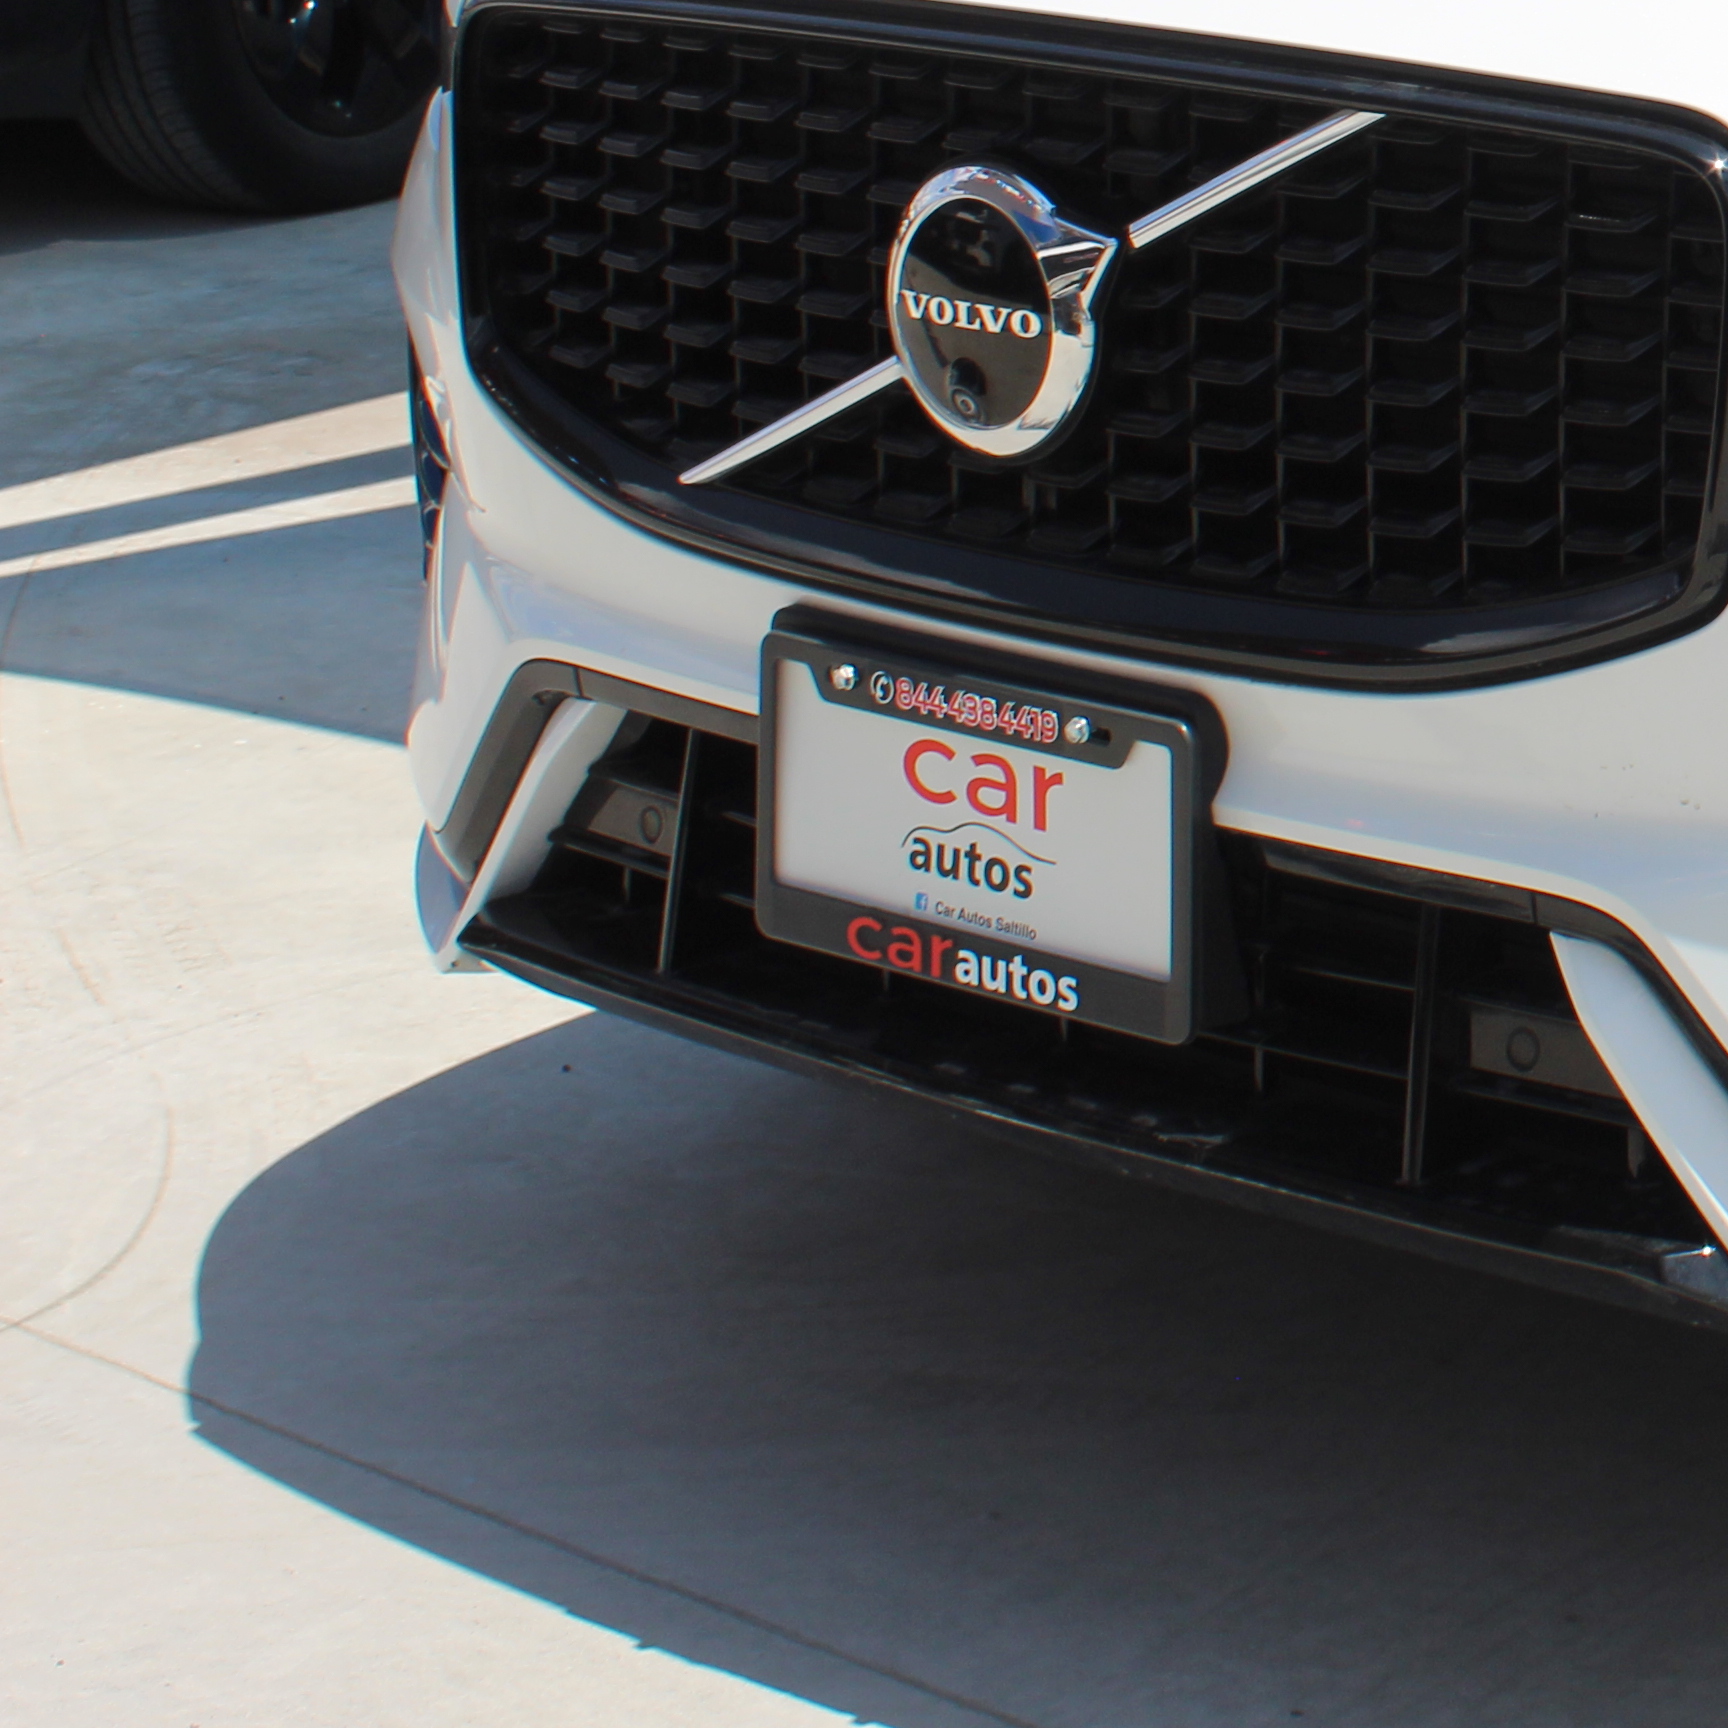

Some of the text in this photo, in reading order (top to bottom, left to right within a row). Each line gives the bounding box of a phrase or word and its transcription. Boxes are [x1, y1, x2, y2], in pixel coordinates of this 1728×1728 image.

[901, 289, 1043, 339] VOLVO
[903, 738, 1064, 832] car
[909, 837, 1035, 899] autos
[935, 901, 1037, 941] Car Autos Saltillo
